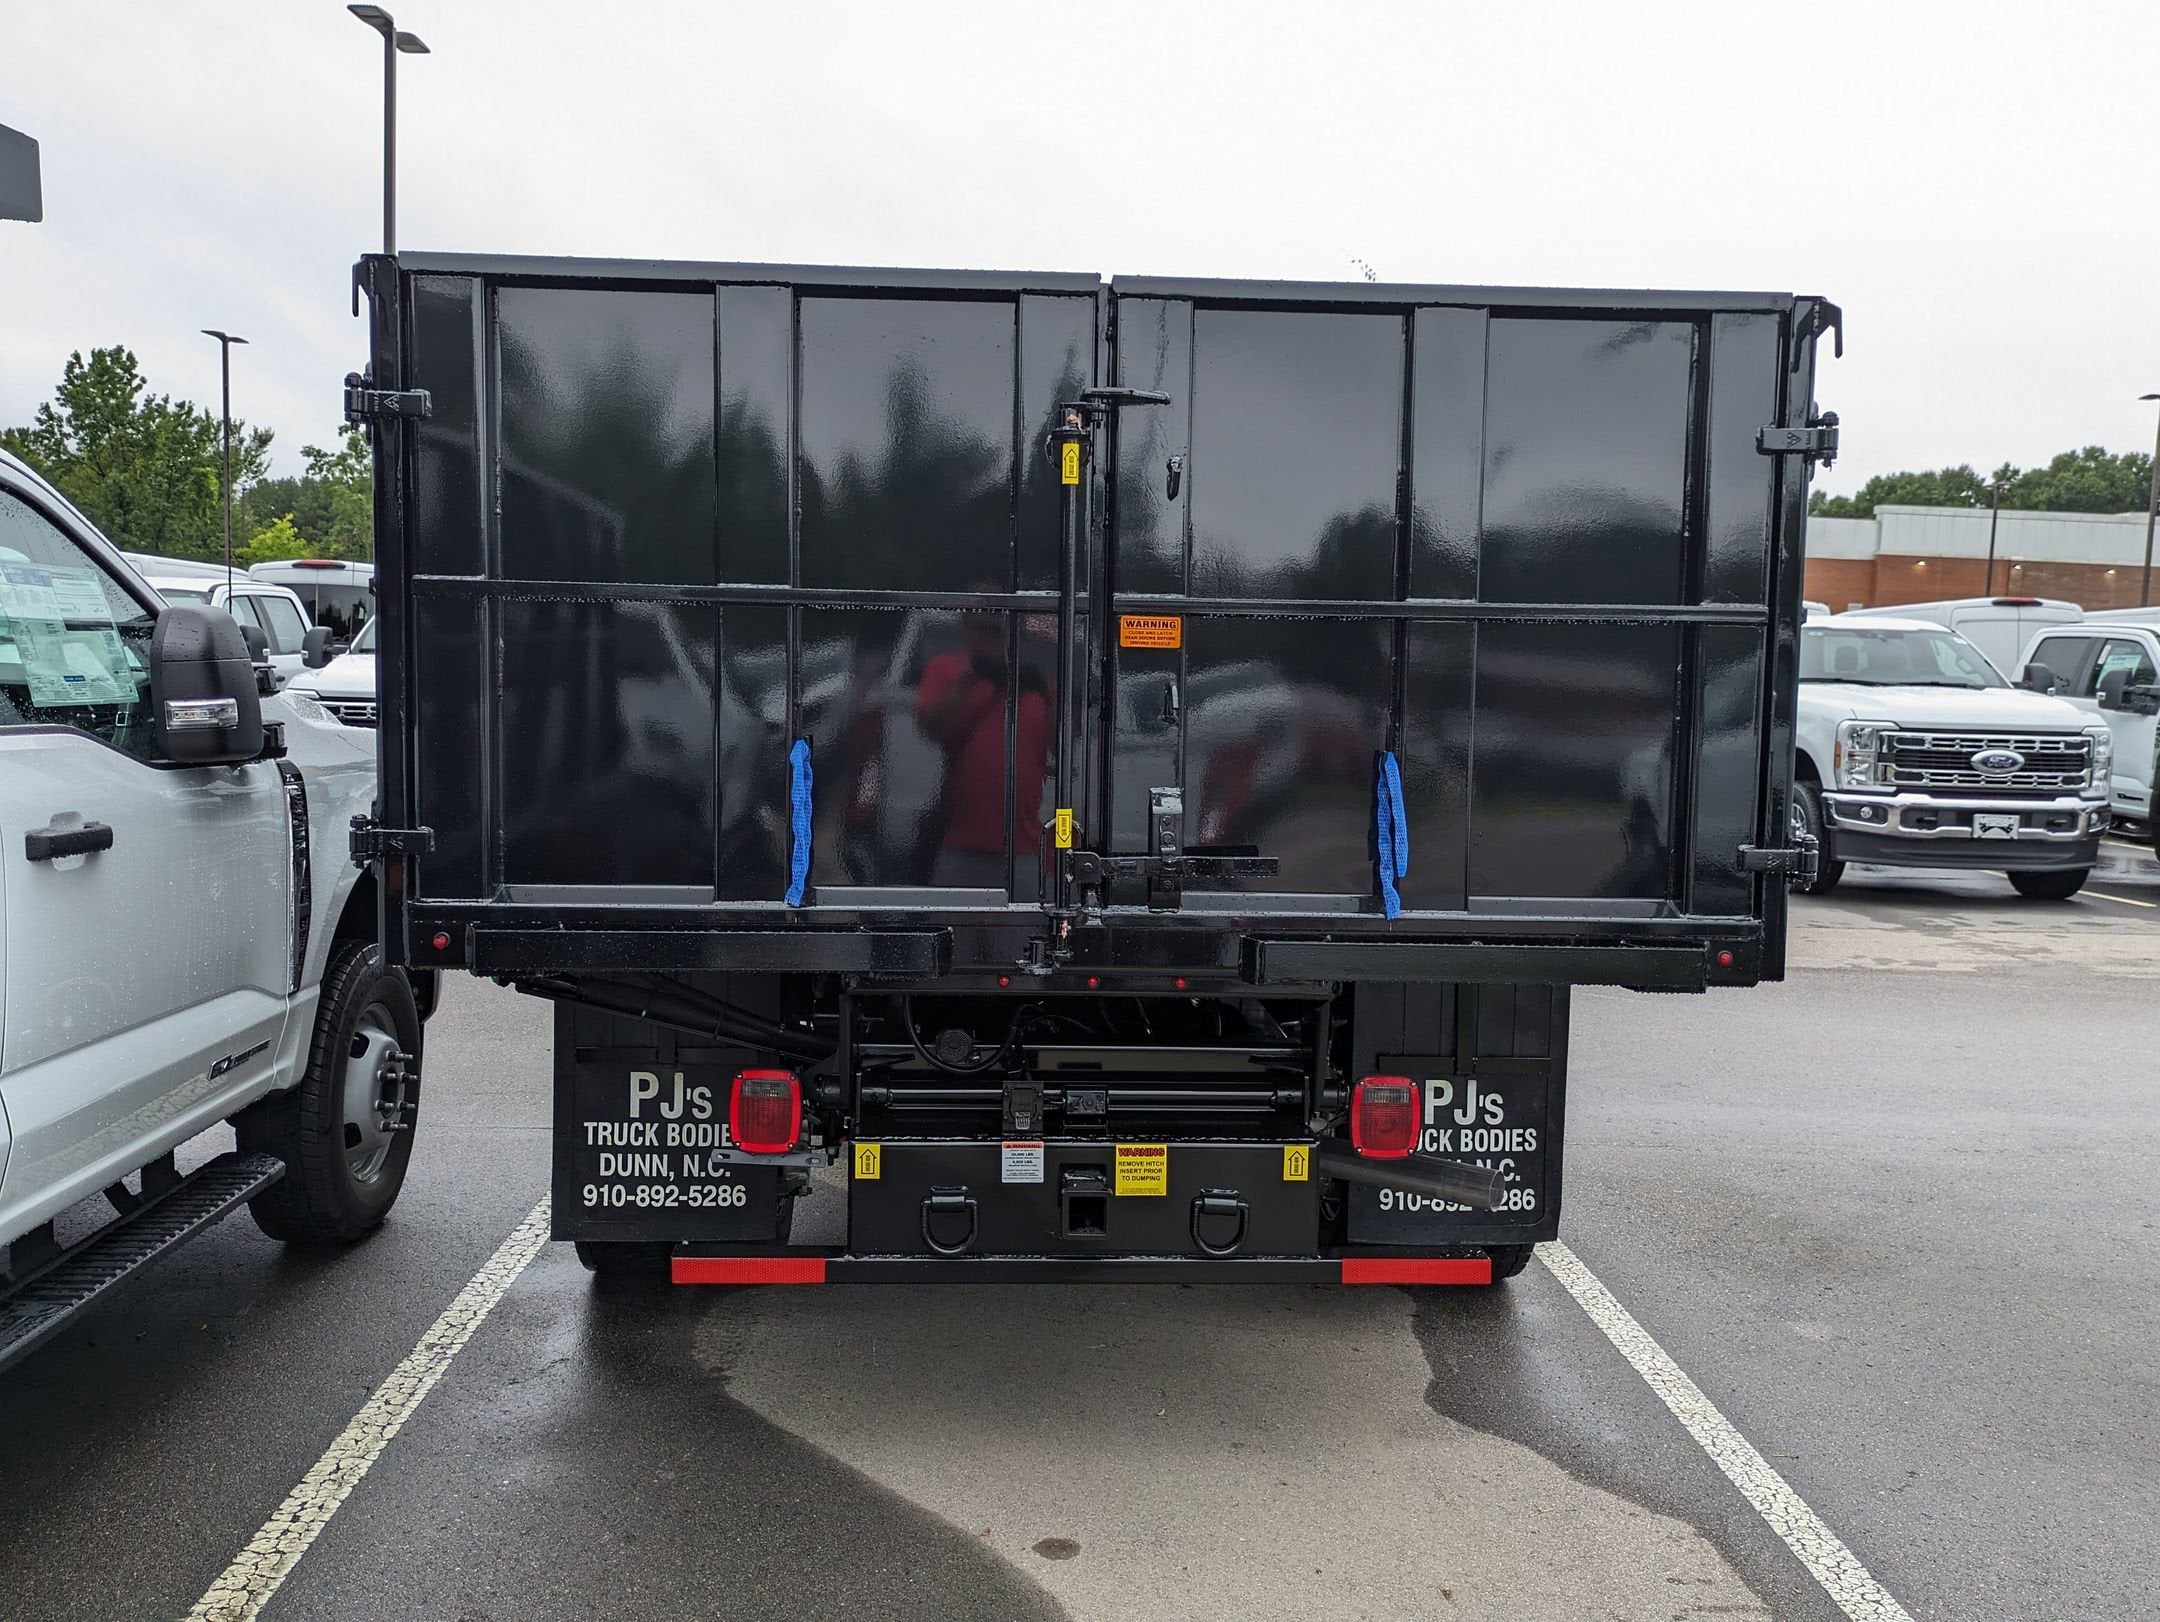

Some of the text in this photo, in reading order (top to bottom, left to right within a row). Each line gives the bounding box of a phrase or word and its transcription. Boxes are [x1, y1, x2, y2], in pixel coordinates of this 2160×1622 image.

[1125, 620, 1177, 629] WARNING
[583, 1122, 733, 1147] TRUCK BODIE
[1460, 1128, 1537, 1152] BODIES
[1117, 1147, 1166, 1157] WARNING
[599, 1153, 731, 1181] DUNN, N.C.
[583, 1184, 747, 1207] 910-892-5286
